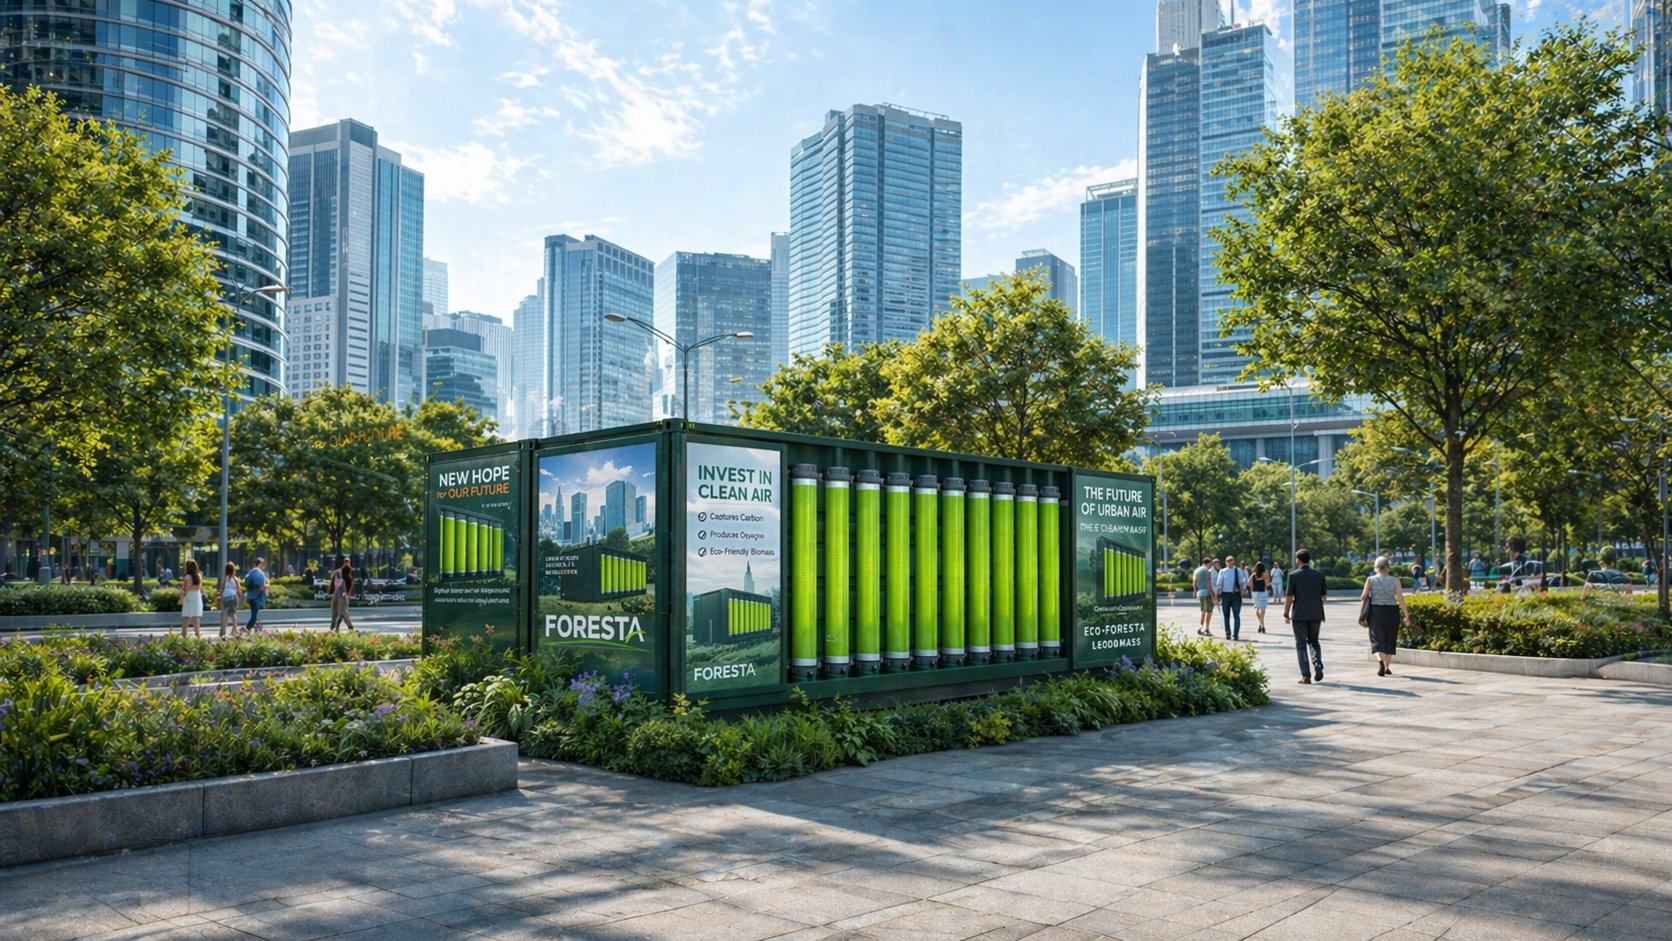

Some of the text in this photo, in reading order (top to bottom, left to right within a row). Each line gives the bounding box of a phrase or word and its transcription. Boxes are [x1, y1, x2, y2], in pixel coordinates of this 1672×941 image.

[439, 465, 510, 487] NEW HOPE
[698, 464, 772, 485] INVEST IN
[448, 486, 469, 498] OUR
[471, 483, 509, 496] FUTURE
[698, 484, 772, 502] CLEAN AIR
[1083, 486, 1142, 503] THE FUTURE
[710, 512, 764, 522] Captures Carbon
[1081, 502, 1147, 518] OF URBAN AIR
[545, 614, 645, 642] FORESTA
[694, 663, 756, 681] FORESTA
